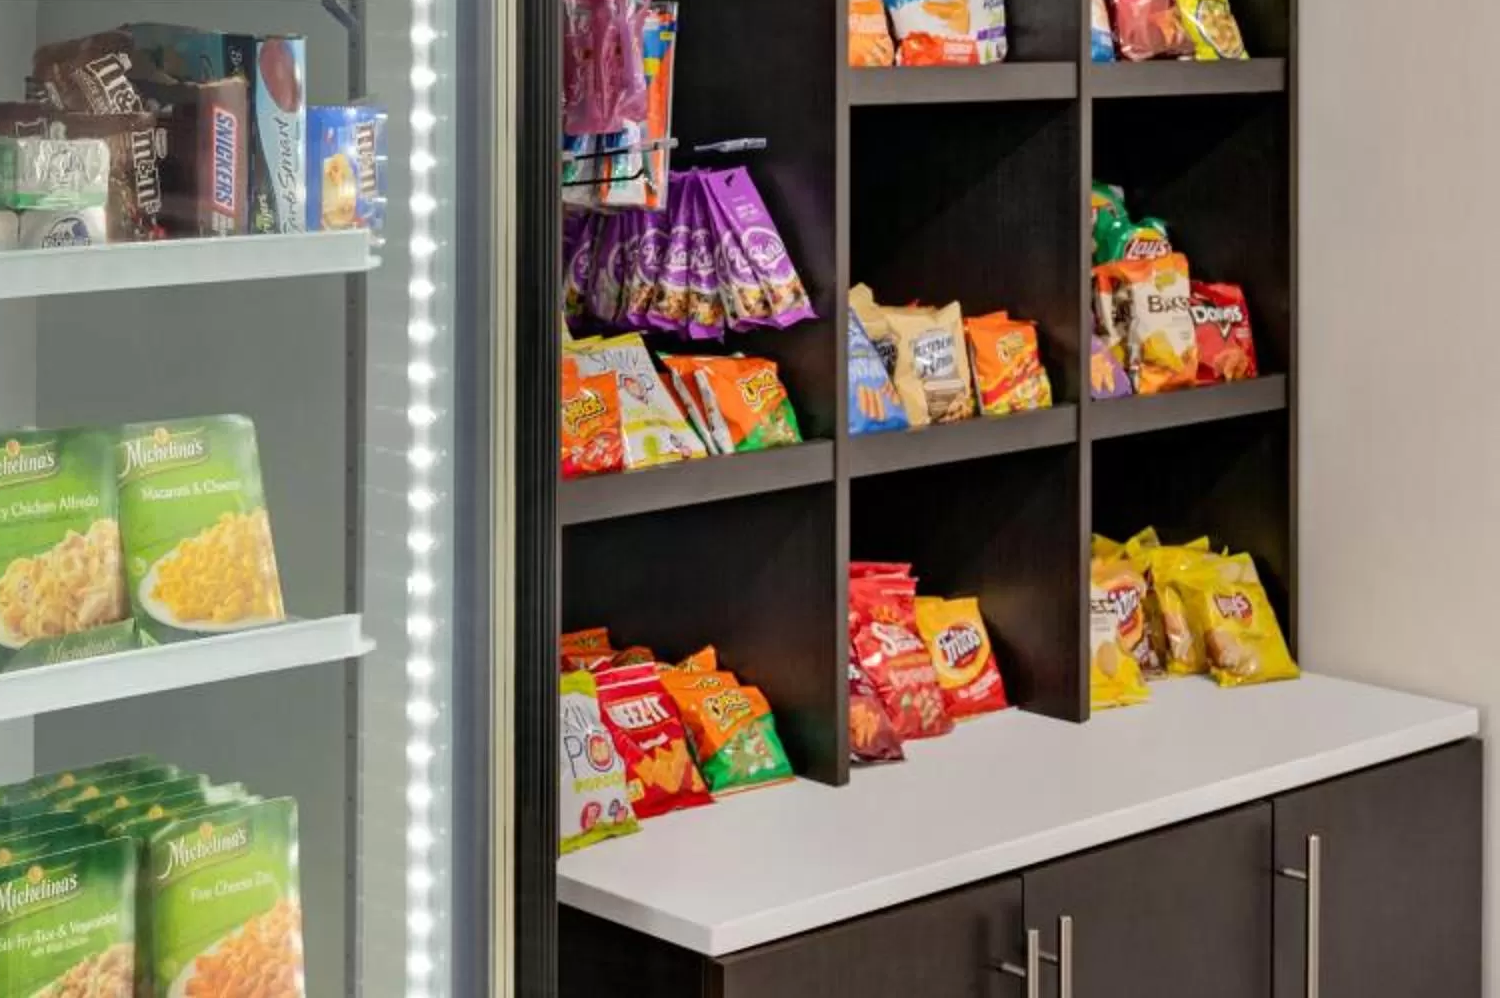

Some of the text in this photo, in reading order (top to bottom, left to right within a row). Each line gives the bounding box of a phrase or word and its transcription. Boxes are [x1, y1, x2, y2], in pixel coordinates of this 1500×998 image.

[215, 113, 235, 209] SNICKERS
[120, 437, 205, 477] Michelina's
[11, 499, 57, 519] Chicken
[157, 828, 246, 880] Michelina's
